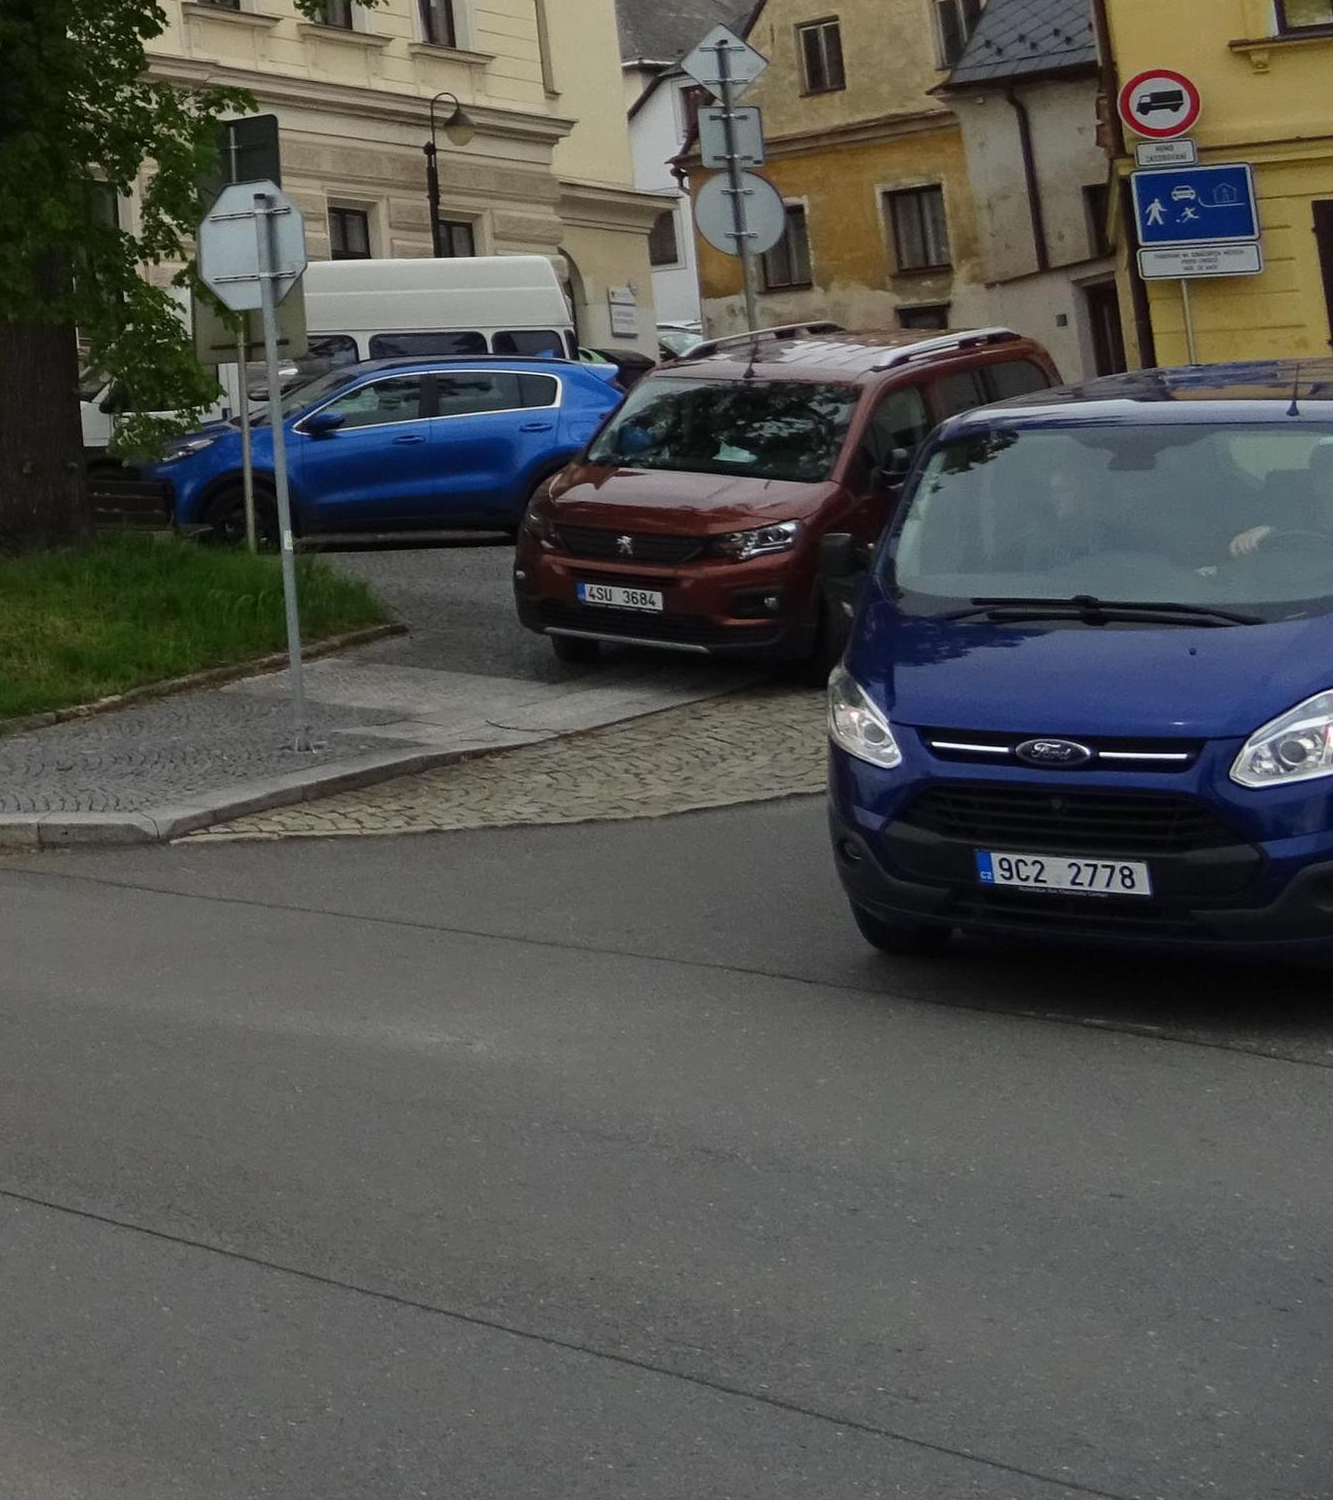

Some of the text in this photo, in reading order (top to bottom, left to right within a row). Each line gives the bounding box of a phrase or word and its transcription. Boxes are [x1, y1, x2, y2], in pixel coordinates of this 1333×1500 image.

[588, 586, 656, 606] 4SU 3684
[1031, 742, 1071, 759] Ford
[980, 871, 992, 880] CZ
[998, 857, 1136, 889] 9C2 2778
